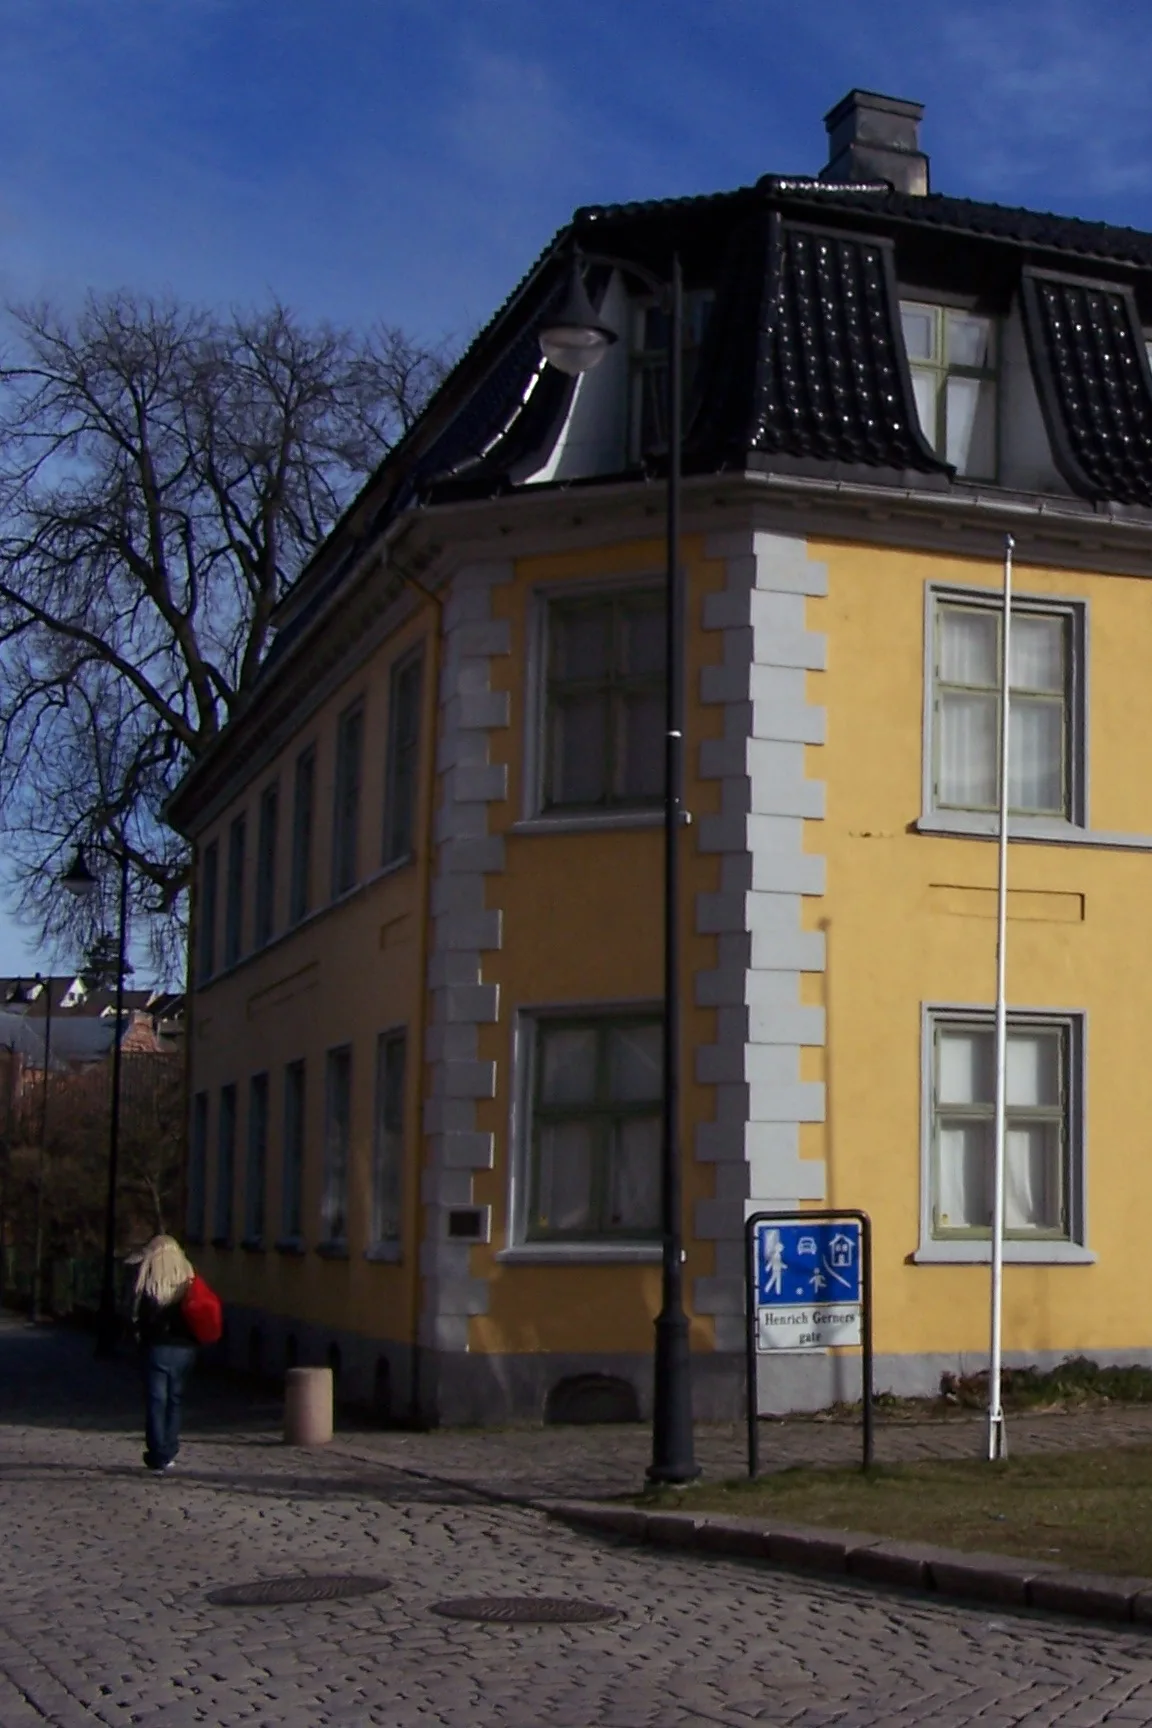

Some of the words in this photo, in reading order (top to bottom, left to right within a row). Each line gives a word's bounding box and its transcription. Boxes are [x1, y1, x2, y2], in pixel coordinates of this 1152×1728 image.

[764, 1312, 808, 1326] Henrich
[812, 1310, 856, 1325] Gerners
[799, 1331, 822, 1344] gate
